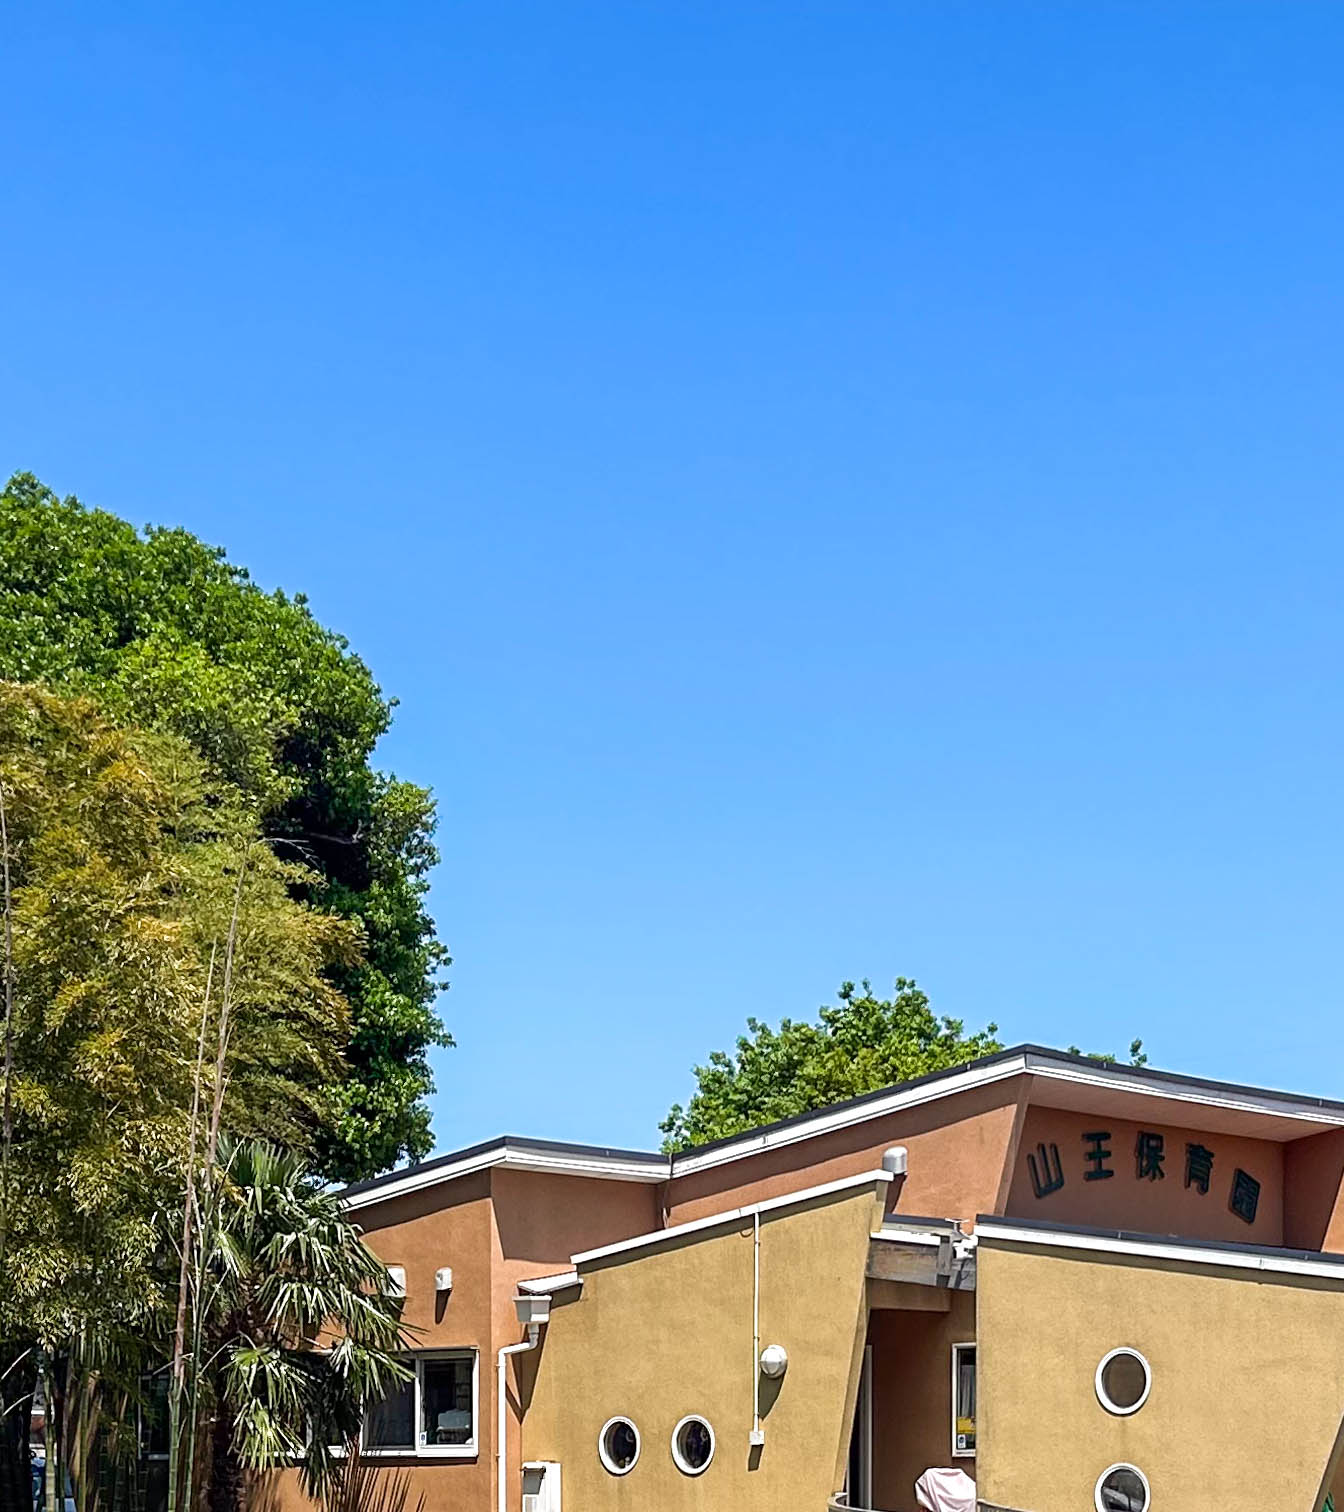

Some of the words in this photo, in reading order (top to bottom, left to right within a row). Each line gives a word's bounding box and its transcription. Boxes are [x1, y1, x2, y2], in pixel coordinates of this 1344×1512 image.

[1027, 1130, 1261, 1225] 山王保育園
